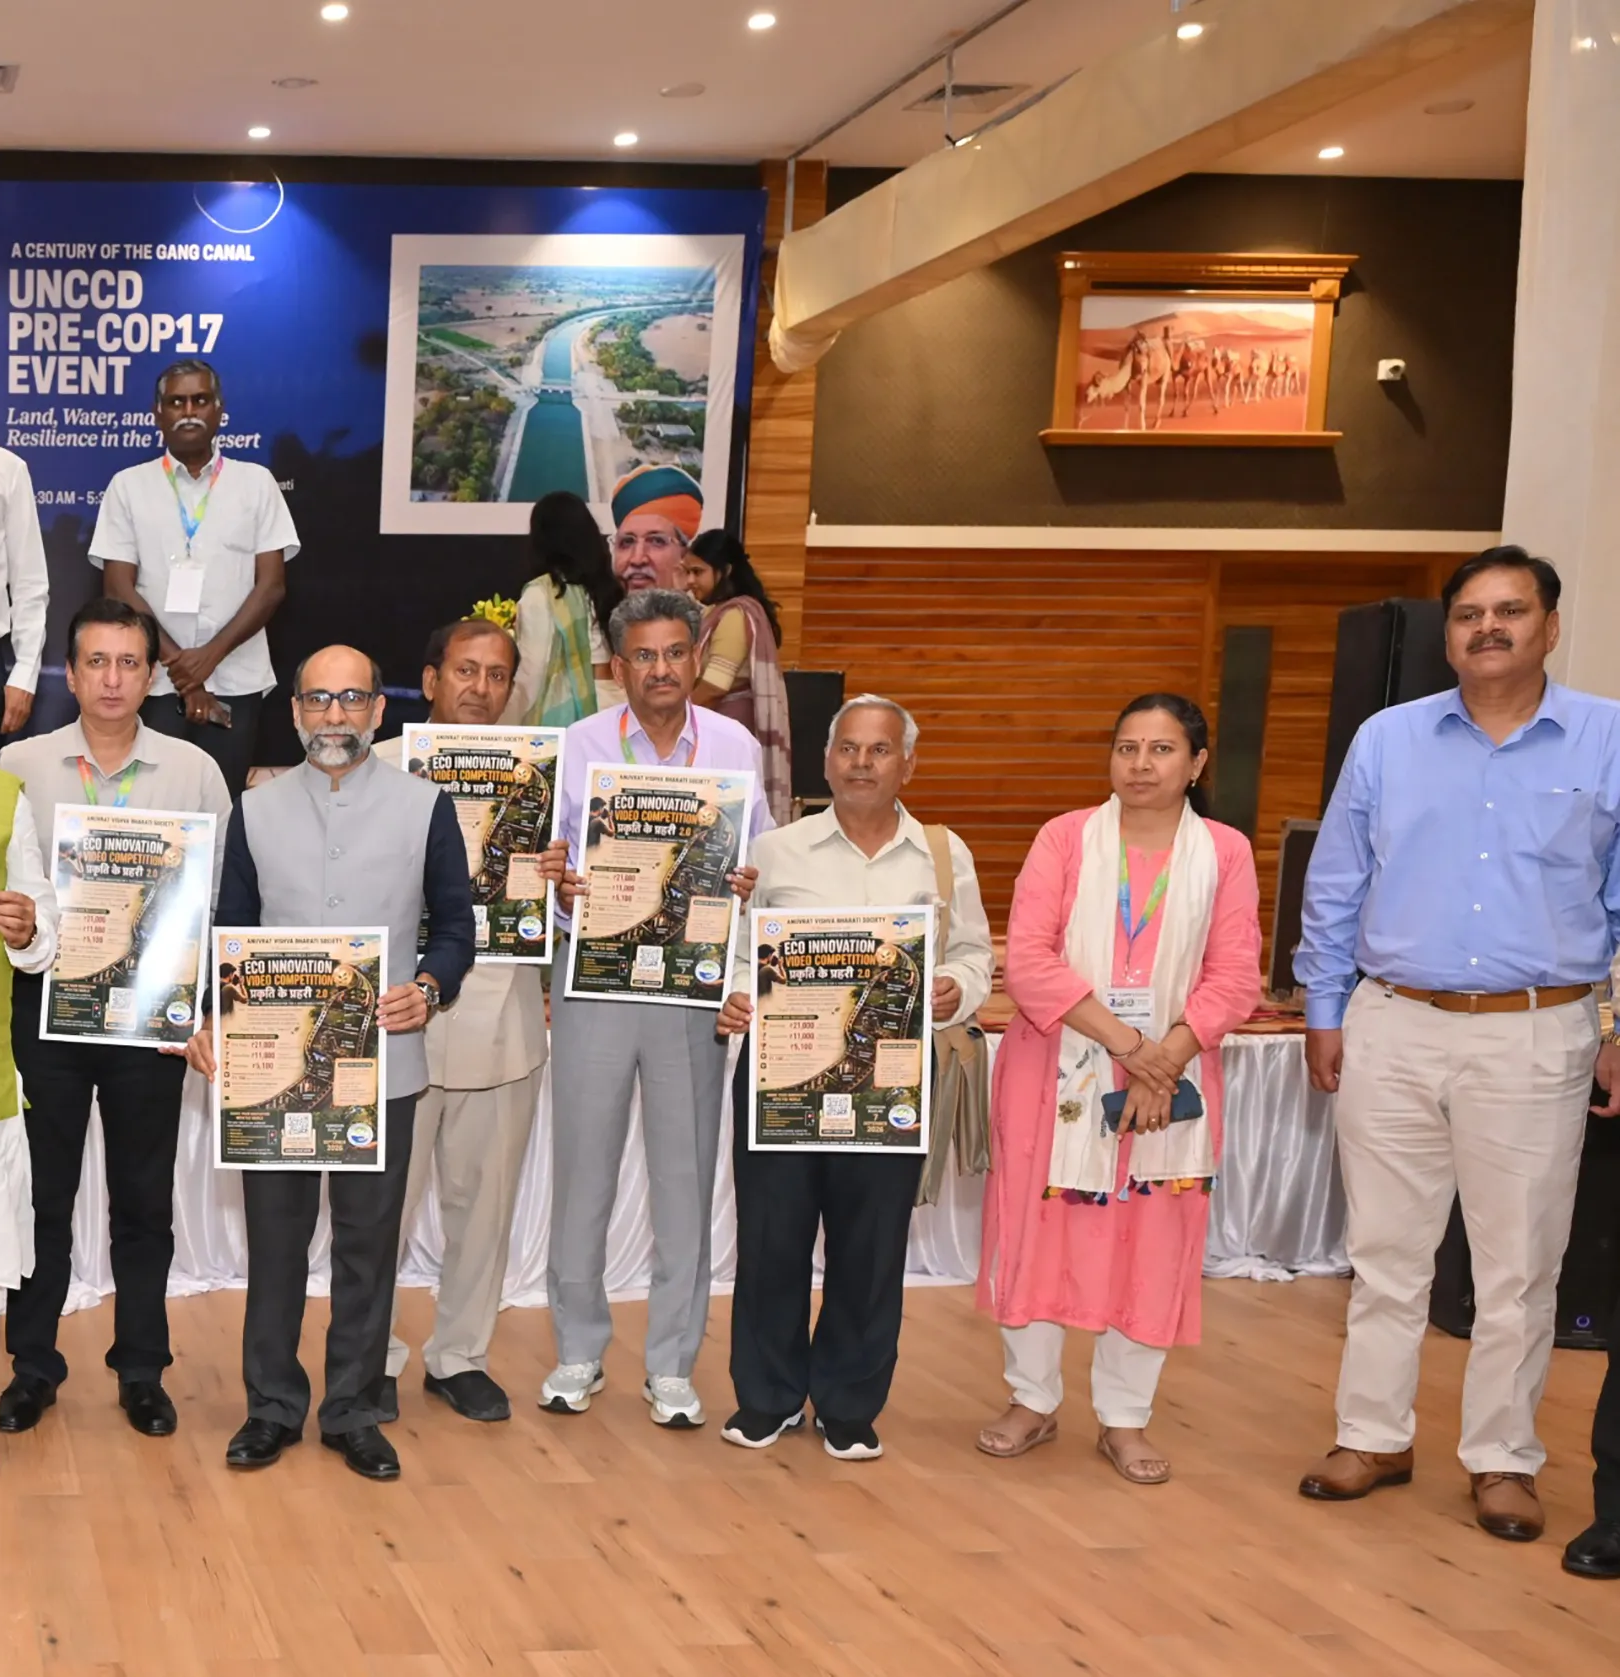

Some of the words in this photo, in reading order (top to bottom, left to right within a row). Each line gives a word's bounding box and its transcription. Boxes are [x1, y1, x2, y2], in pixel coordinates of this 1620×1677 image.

[11, 243, 21, 258] A
[25, 243, 97, 259] CENTURY
[101, 244, 120, 259] OF
[124, 244, 152, 259] THE
[156, 244, 199, 260] GANG
[203, 245, 255, 261] CANAL
[9, 269, 143, 309] UNCCD
[9, 312, 223, 353] PRE-COP17
[8, 355, 131, 395] EVENT
[7, 407, 58, 428] Land,
[64, 408, 118, 429] Water,
[7, 429, 98, 447] Resilience
[102, 430, 119, 447] in
[123, 430, 151, 447] the
[215, 432, 260, 448] esert
[56, 491, 75, 504] AM
[433, 756, 451, 769] ECO
[455, 756, 513, 771] INNOVATION
[434, 771, 457, 780] VIDEO
[460, 770, 514, 782] COMPETITION
[615, 796, 633, 809] ECO
[637, 796, 698, 812] INNOVATION
[615, 810, 639, 820] VIDEO
[642, 811, 698, 824] COMPETITION
[83, 838, 101, 850] ECO
[105, 838, 163, 854] INNOVATION
[784, 941, 805, 955] ECO
[809, 940, 875, 953] INNOVATION
[245, 960, 265, 974] ECO
[268, 960, 332, 973] INNOVATION
[786, 955, 811, 966] VIDEO
[815, 954, 876, 965] COMPETITION
[247, 975, 271, 985] VIDEO
[274, 974, 333, 985] COMPETITION
[789, 967, 815, 981] प्रकृति
[818, 966, 828, 978] के
[830, 966, 854, 979] प्रहरी
[857, 969, 870, 978] 2.0
[250, 986, 275, 1001] प्रकृति
[278, 986, 287, 998] के
[290, 986, 312, 999] प्रहरी
[316, 989, 328, 998] 2.0
